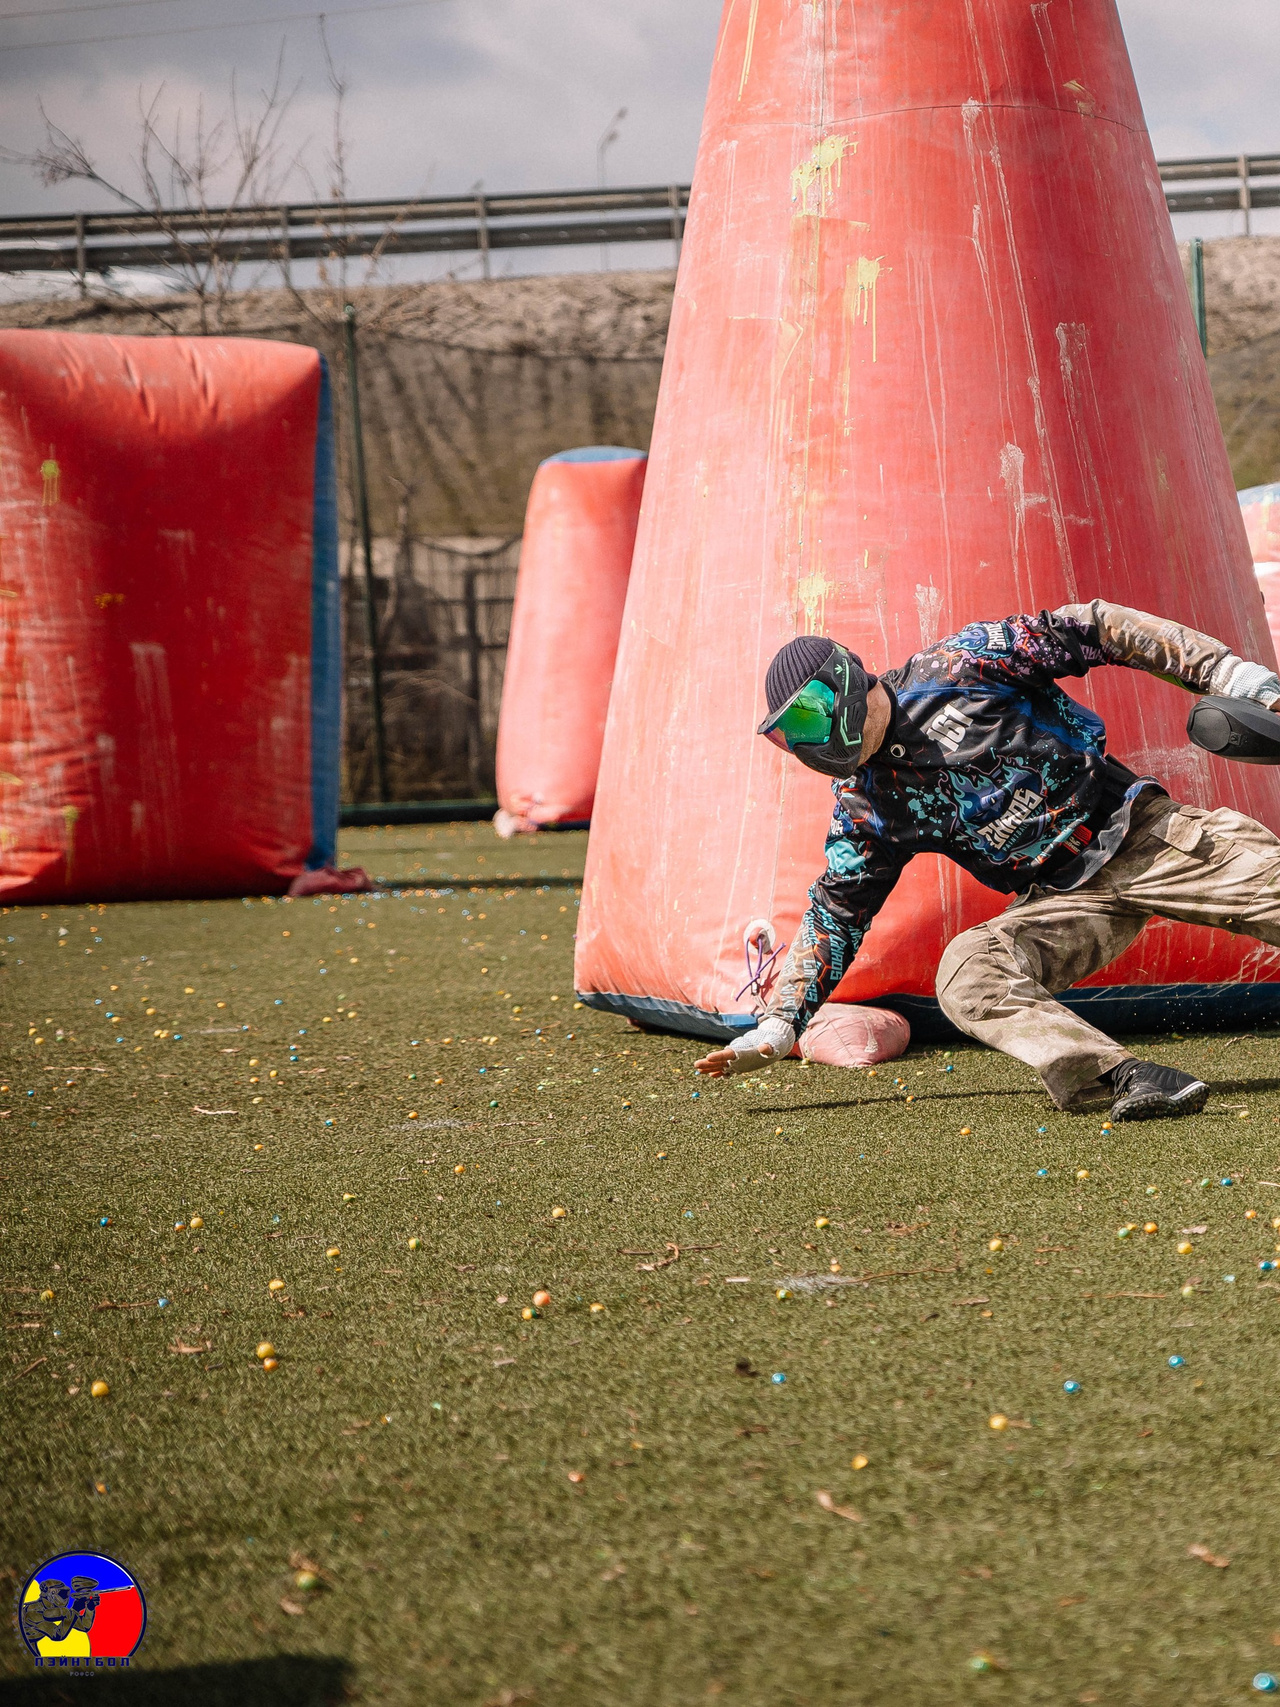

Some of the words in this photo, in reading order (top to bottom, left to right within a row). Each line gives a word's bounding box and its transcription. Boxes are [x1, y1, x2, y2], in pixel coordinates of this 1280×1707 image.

[926, 704, 974, 752] 161
[977, 788, 1043, 850] CHAOS
[1002, 823, 1031, 852] PAINTBALL
[829, 933, 847, 981] CHAOS
